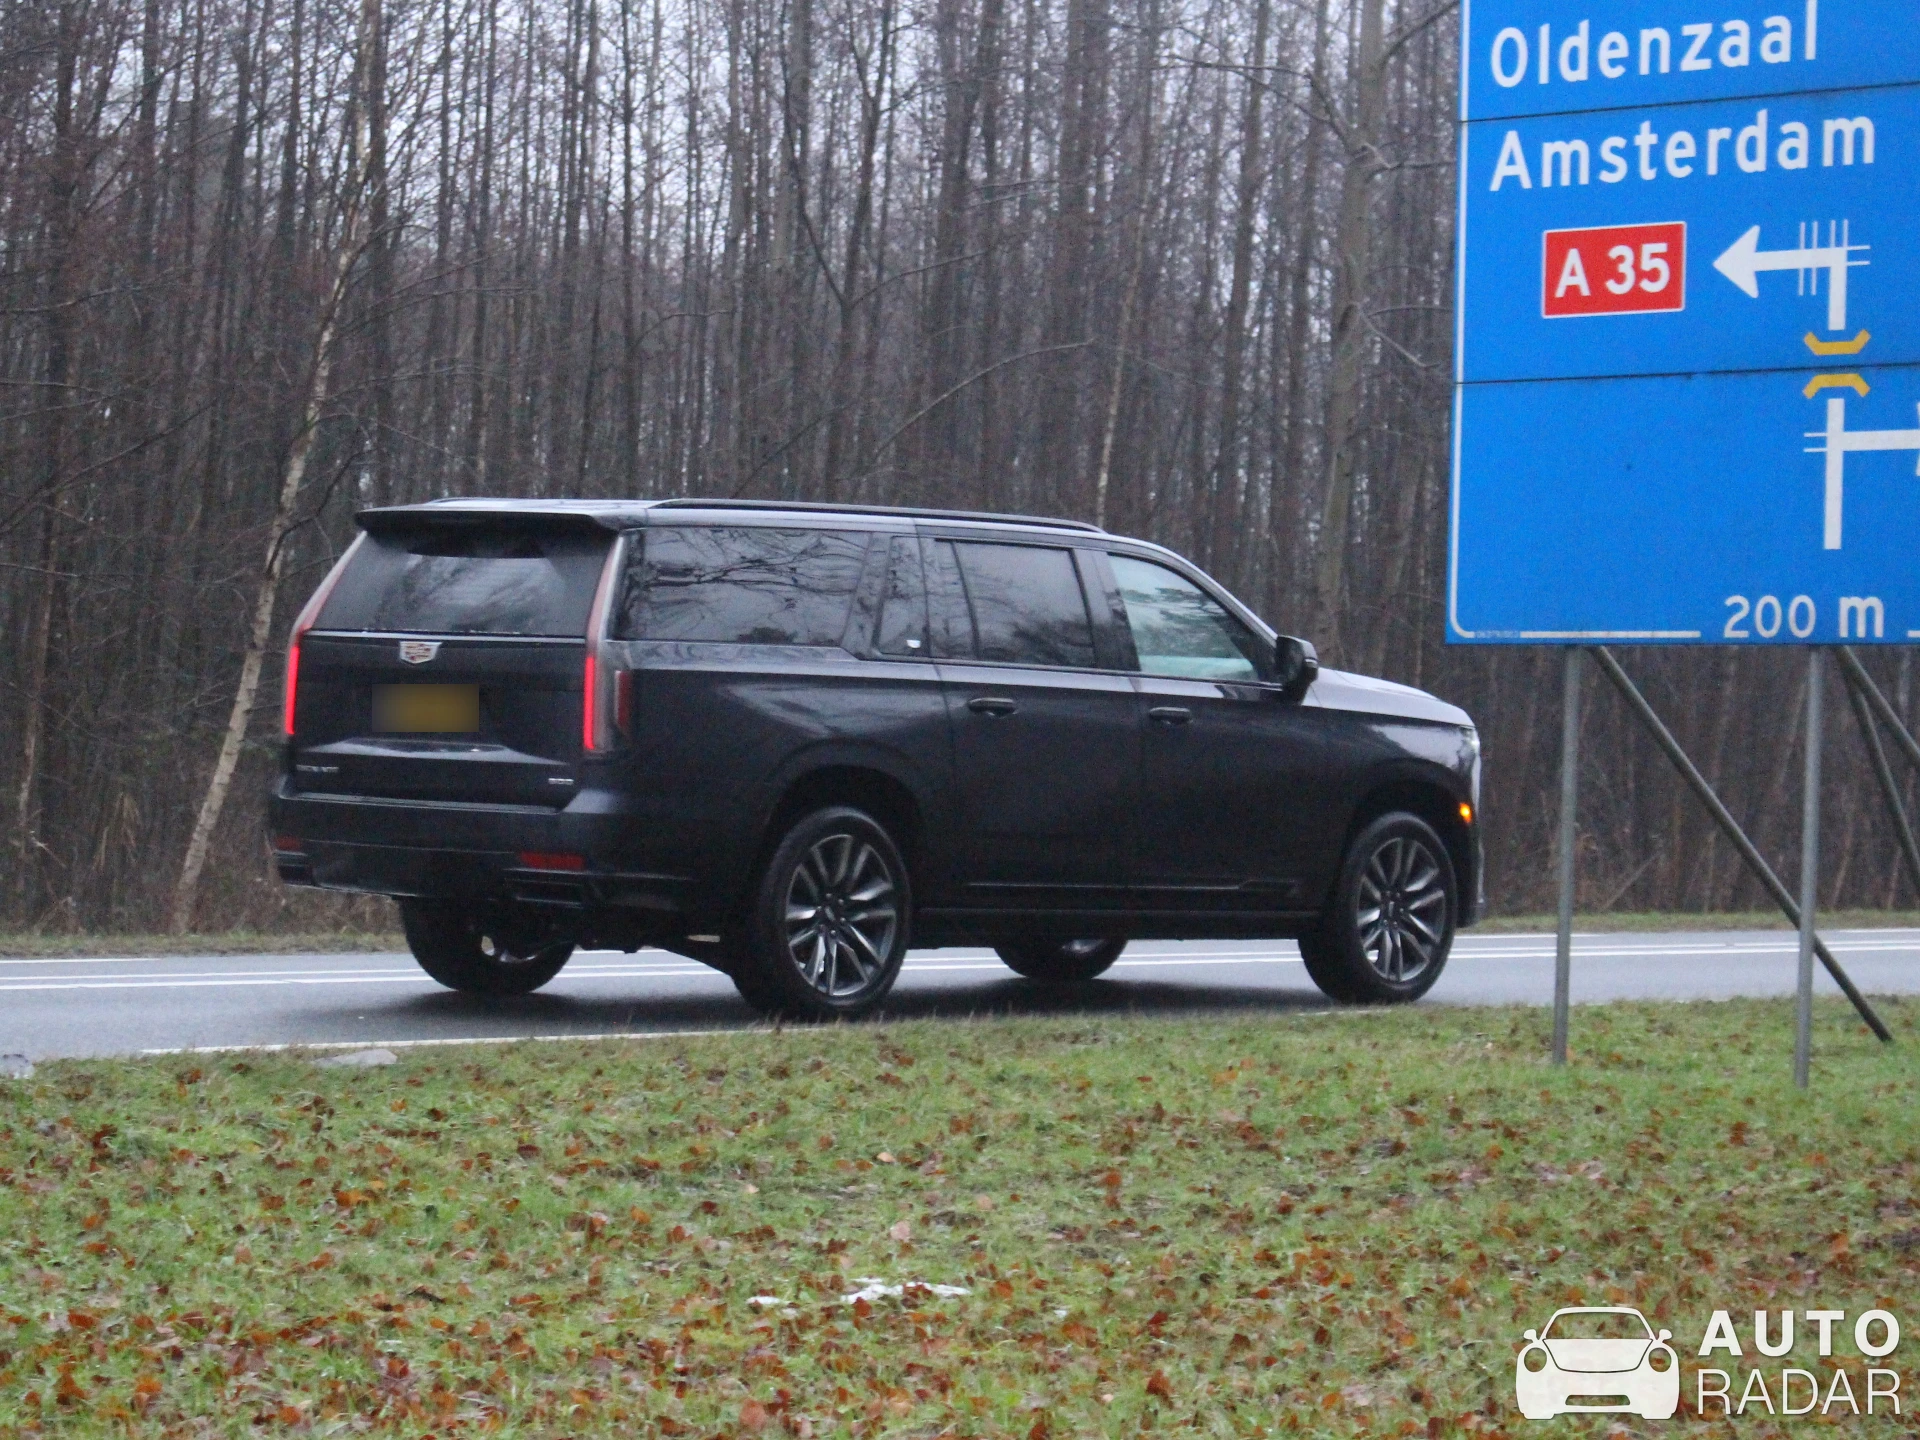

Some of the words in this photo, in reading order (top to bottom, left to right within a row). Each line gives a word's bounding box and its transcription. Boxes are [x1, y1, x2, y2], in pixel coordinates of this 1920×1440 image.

[1490, 0, 1818, 88] Oldenzaal
[1489, 109, 1876, 192] Amsterdam
[1554, 248, 1591, 299] A
[1605, 242, 1671, 296] 35
[1723, 595, 1817, 639] 200
[1838, 596, 1885, 639] m
